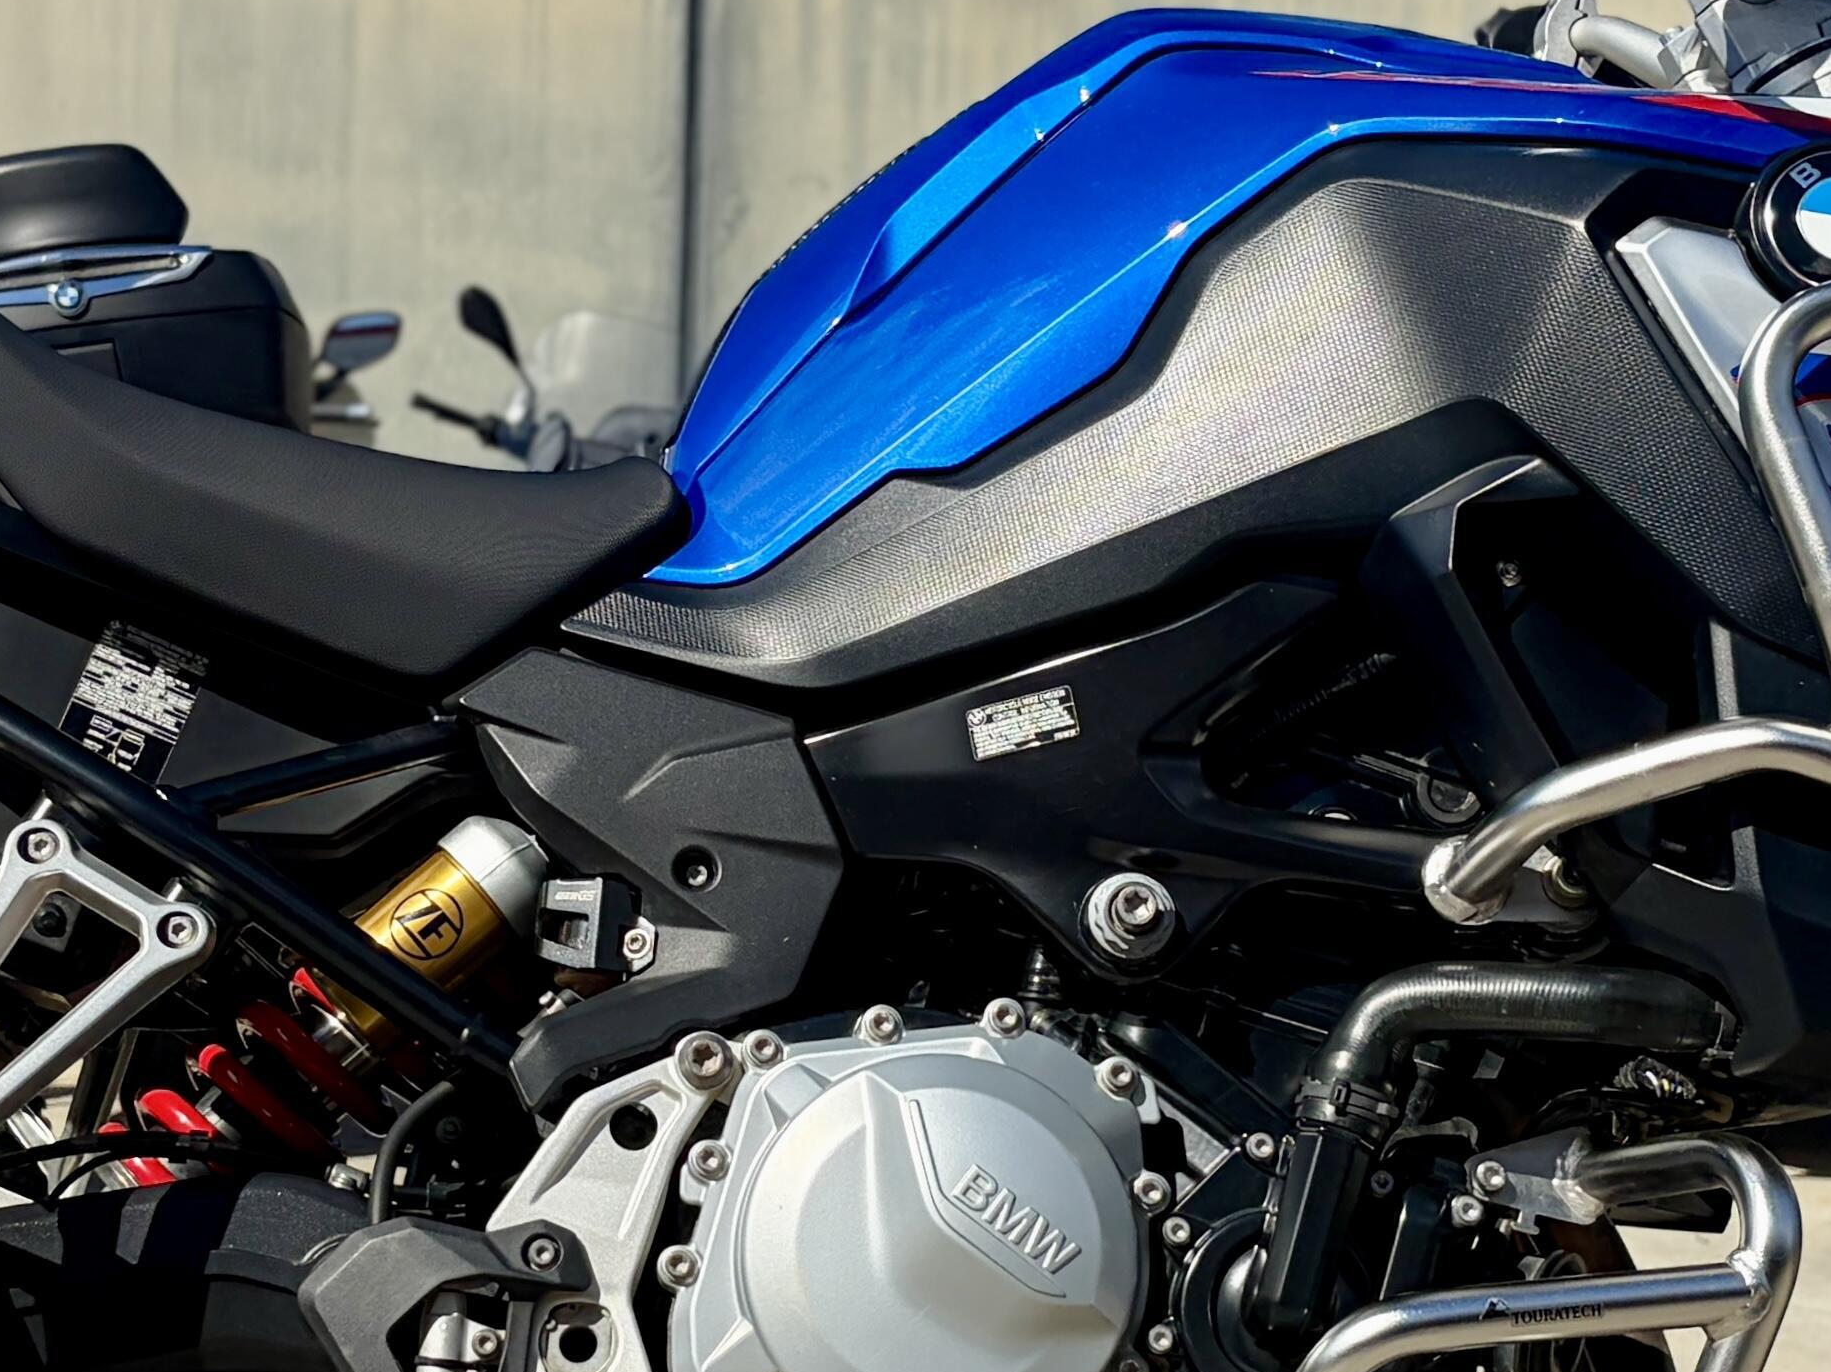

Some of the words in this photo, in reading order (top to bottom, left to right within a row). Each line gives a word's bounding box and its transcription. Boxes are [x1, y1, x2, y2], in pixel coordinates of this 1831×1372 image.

[391, 889, 463, 960] ZF
[951, 1163, 1082, 1275] BMW
[1511, 1304, 1603, 1325] TOURATECH
